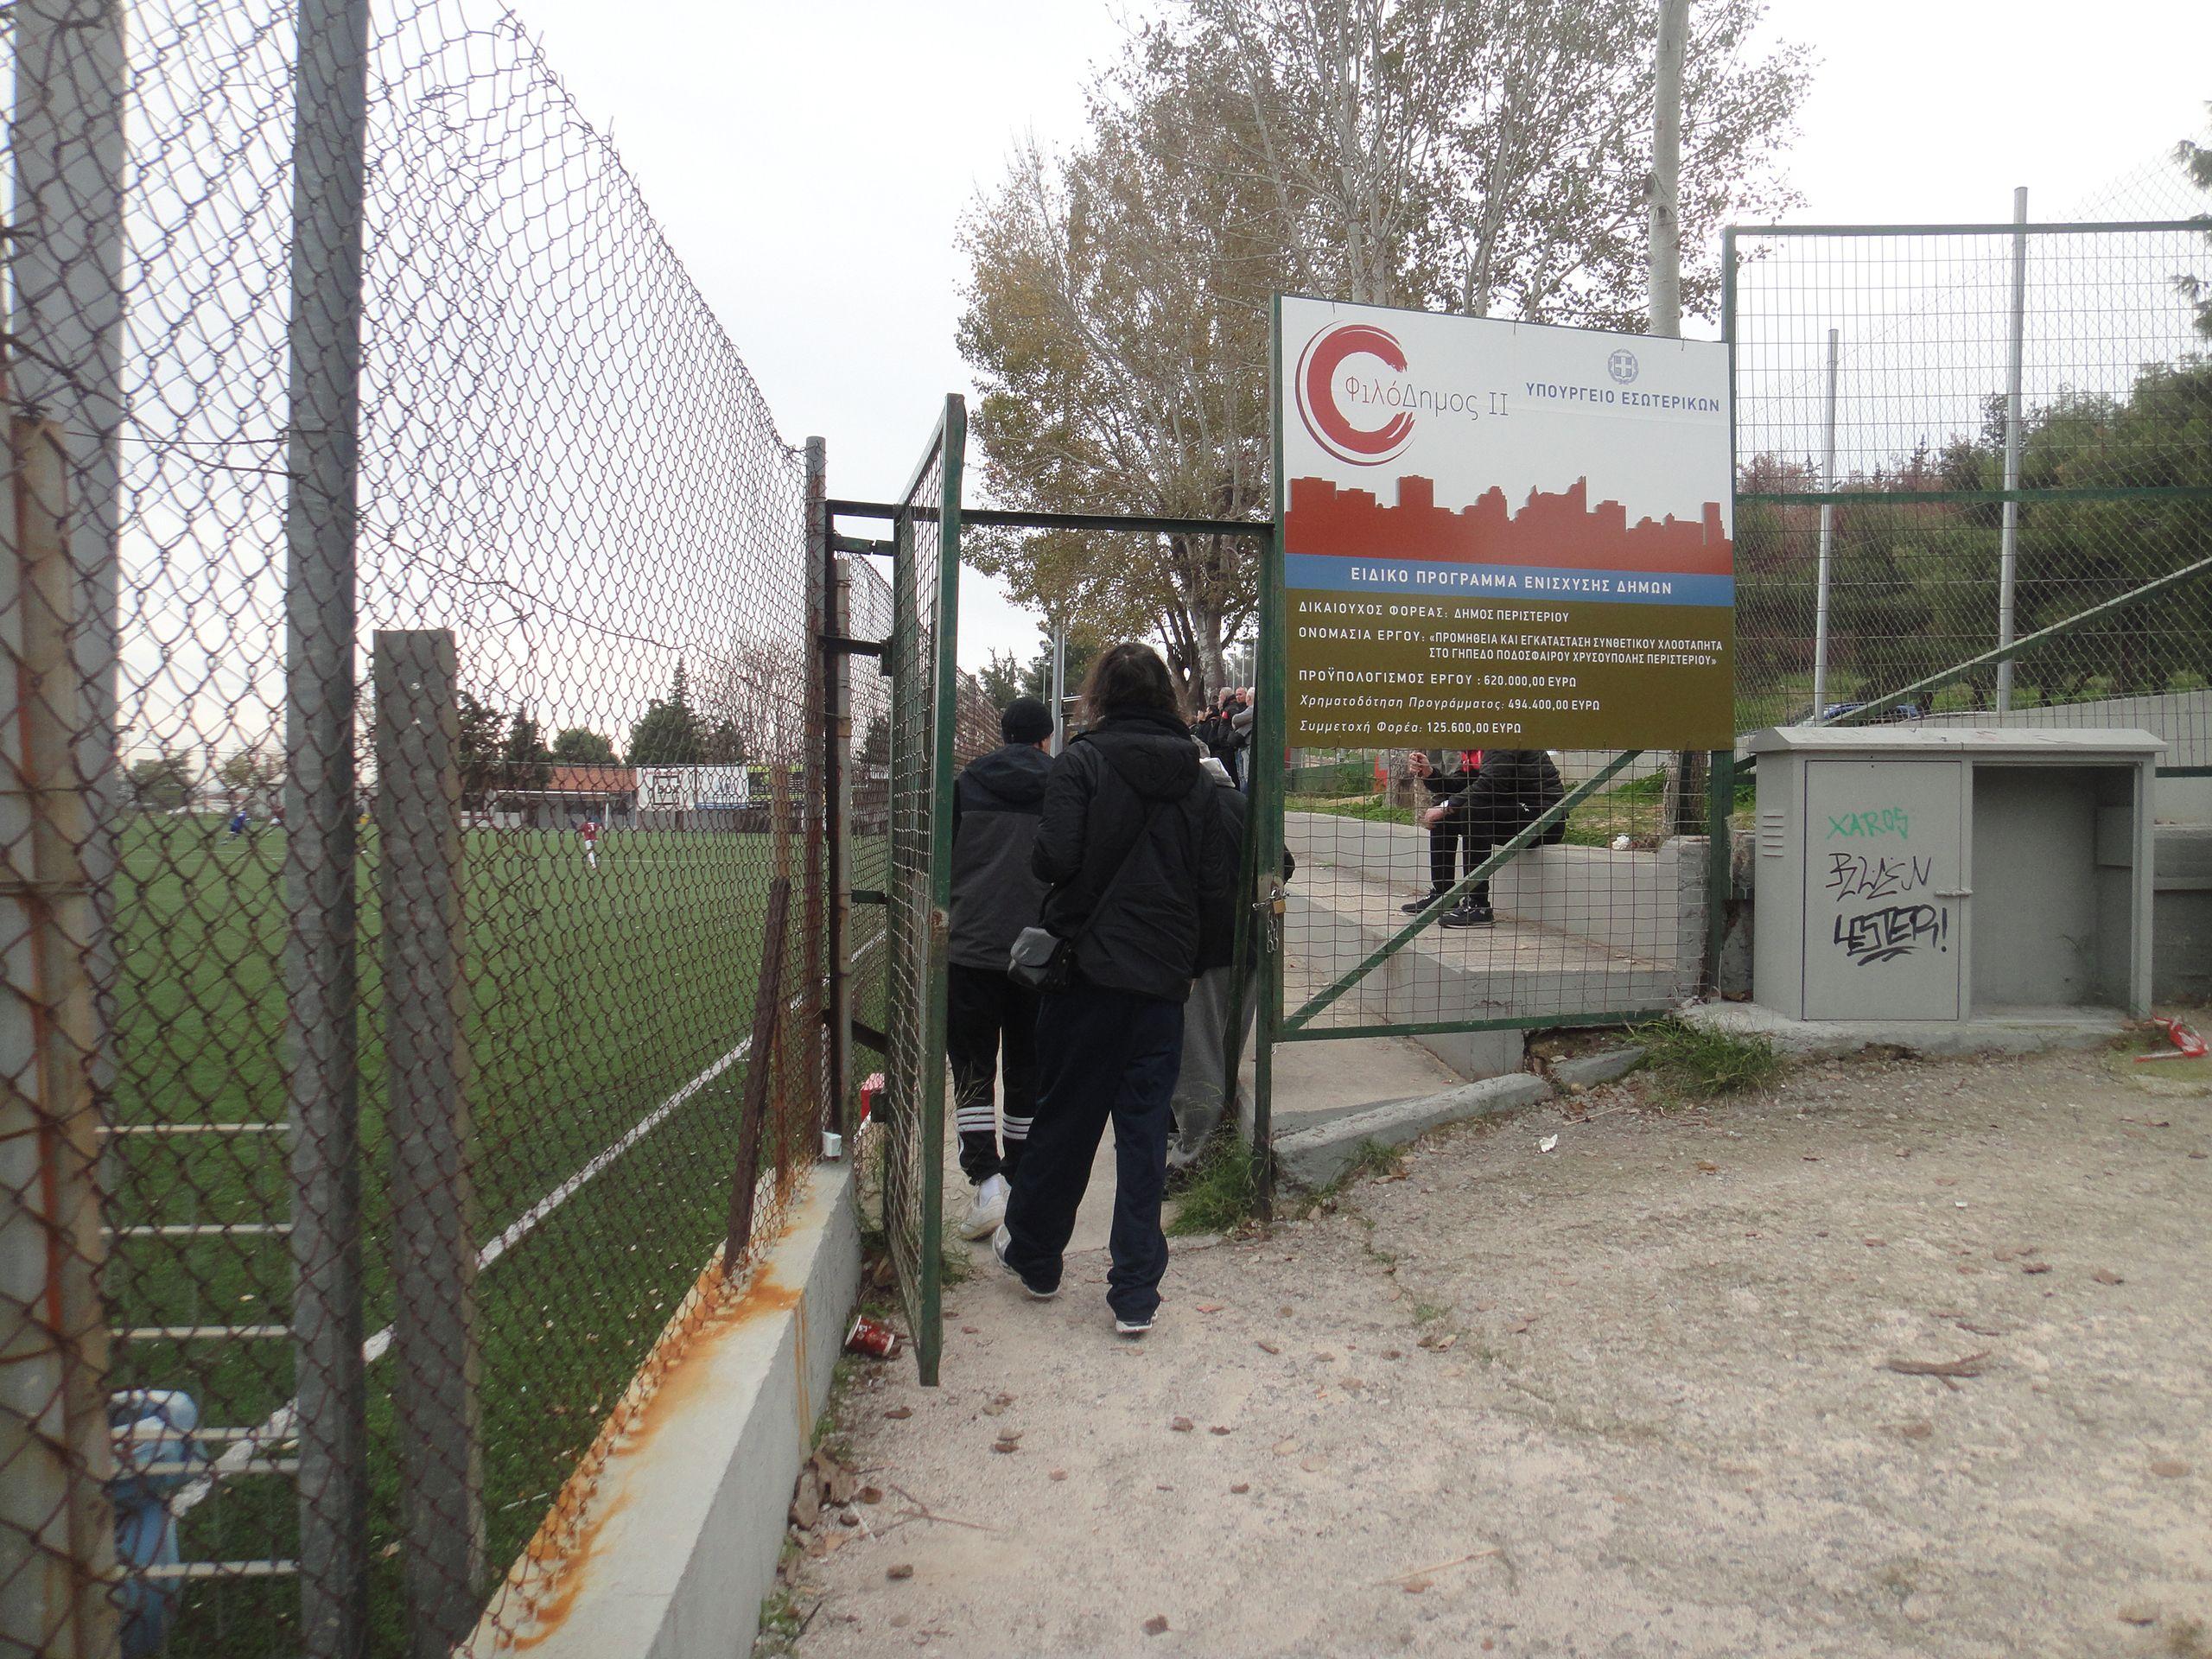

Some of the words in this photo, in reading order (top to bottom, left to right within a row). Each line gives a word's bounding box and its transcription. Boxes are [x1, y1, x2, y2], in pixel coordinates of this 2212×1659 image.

[1344, 375, 1478, 421] ΦιλόΔημος
[1526, 382, 1615, 404] ΥΠΟΥΡΓΕΙΟ
[1621, 391, 1720, 413] ΕΣΩΤΕΡΙΚΩΝ
[1351, 567, 1408, 582] ΕΙΔΙΚΟ
[1416, 570, 1517, 588] ΠΡΟΓΡΑΜΜΑ
[1525, 575, 1610, 592] ΕΝΙΣΧΥΣΗΣ
[1617, 580, 1672, 594] ΔΗΜΩΝ
[1299, 601, 1382, 615] ΔΙΚΑΙΟΥΧΟΣ
[1389, 605, 1448, 619] ΦΟΡΕΑΣ:
[1454, 608, 1493, 620] ΔΗΜΟΣ
[1497, 609, 1569, 622] ΠΕΡΙΣΤΕΡΙΟΥ
[1299, 626, 1371, 640] ΟΝΟΜΑΣΙΑ
[1377, 630, 1425, 642] ΕΡΓΟΥ:
[1429, 632, 1498, 645] «ΠΡΟΜΗΘΕΙΑ
[1500, 634, 1518, 645] ΚΑΙ
[1521, 635, 1591, 647] ΕΓΚΑΤΑΣΤΑΣΗ
[1593, 637, 1656, 650] ΣΥΝΘΕΤΙΚΟΥ
[1658, 639, 1723, 651] ΧΛΟΟΤΑΠΗΤΑ
[1429, 647, 1449, 658] ΣΤΟ
[1452, 648, 1494, 659] ΓΗΠΕΔΟ
[1497, 649, 1570, 662] ΠΟΔΟΣΦΑΙΡΟΥ
[1573, 652, 1644, 664] ΧΡΥΣΟΥΠΟΛΗΣ
[1647, 653, 1717, 665] ΠΕΡΙΣΤΕΡΙΟΥ»
[1299, 667, 1425, 684] ΠΡΟΫΠΟΛΟΓΙΣΜΟΣ
[1484, 676, 1545, 688] 620.000,00
[1548, 676, 1576, 688] ΕΥΡΩ
[1300, 694, 1403, 710] Χρηματοδότηση
[1408, 696, 1505, 711] Προγράμματος:
[1508, 698, 1569, 711] 494.400,00
[1572, 700, 1599, 711] ΕΥΡΩ
[1300, 720, 1371, 734] Συμμετοχή
[1376, 721, 1422, 734] Φορέα:
[1427, 722, 1489, 734] 125.600,00
[1492, 722, 1521, 734] ΕΥΡΩ
[1834, 904, 1948, 957] LESTER!
